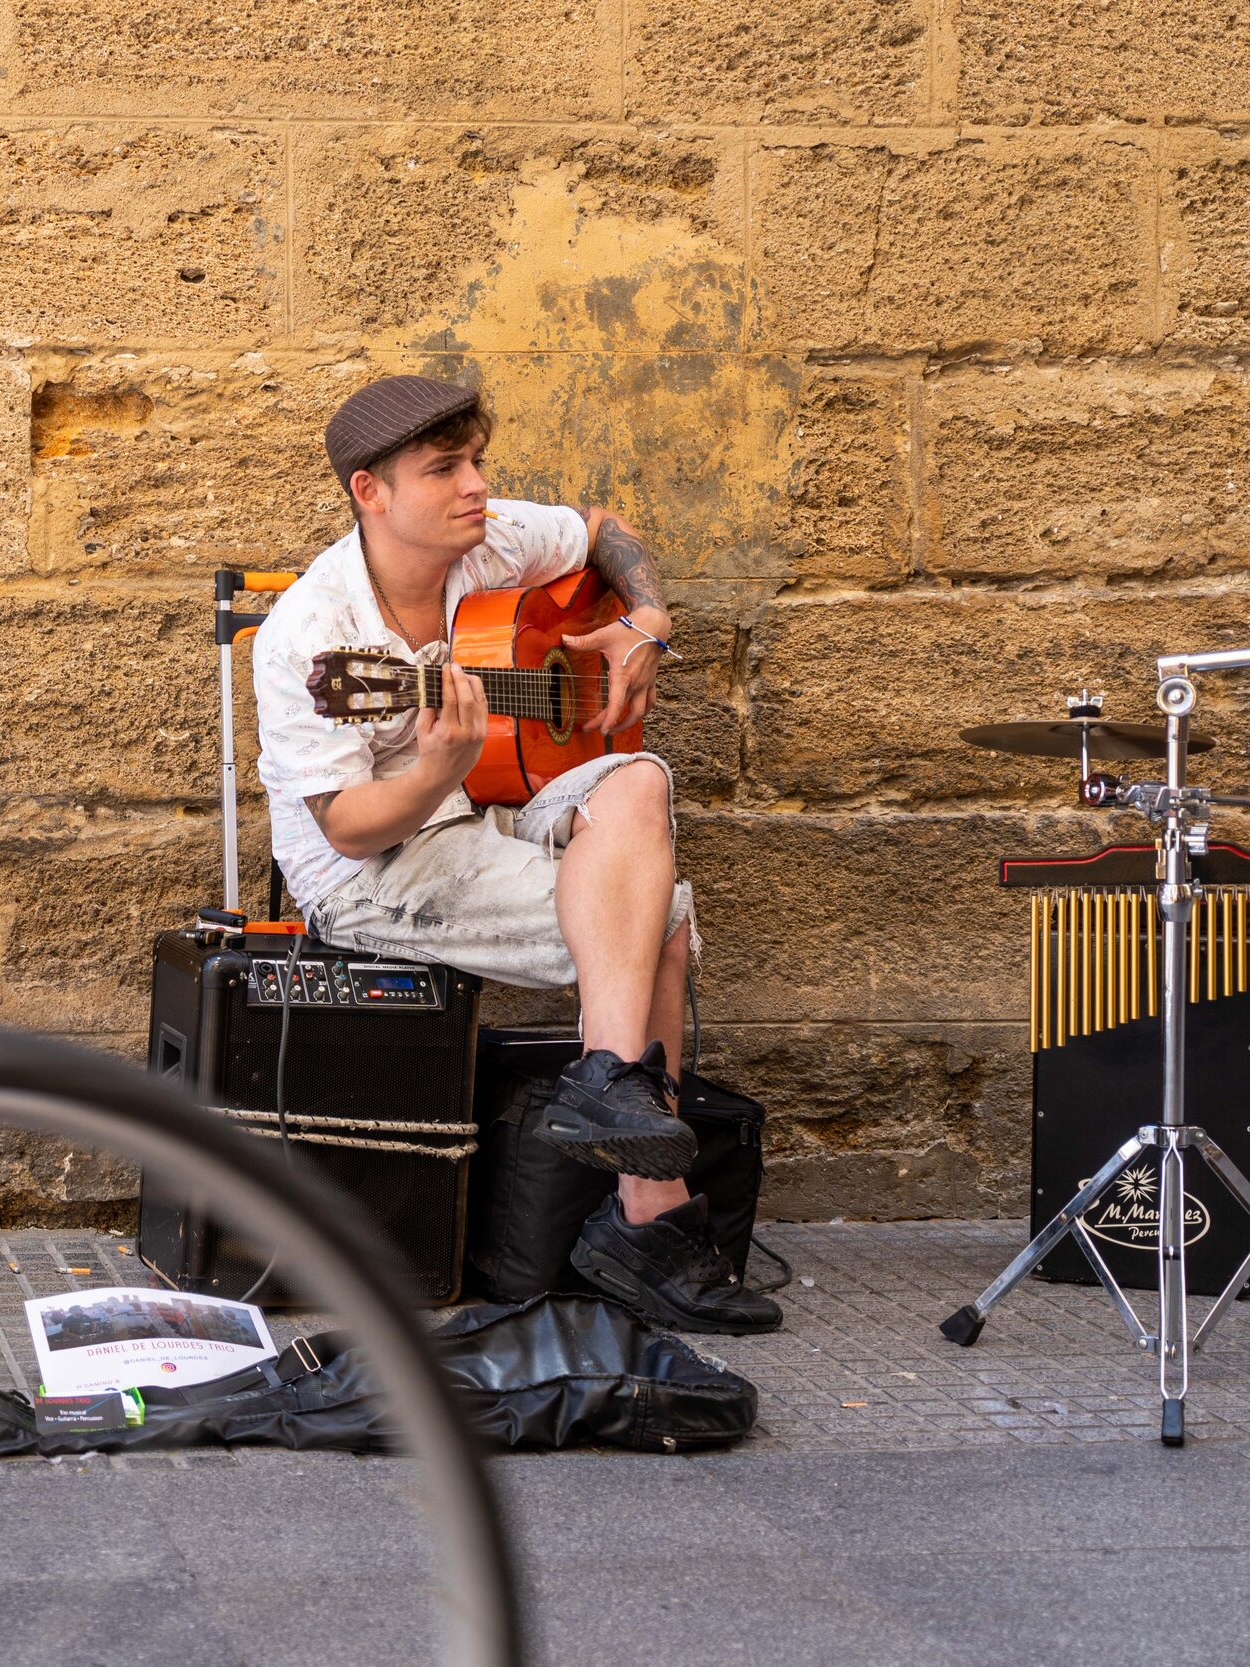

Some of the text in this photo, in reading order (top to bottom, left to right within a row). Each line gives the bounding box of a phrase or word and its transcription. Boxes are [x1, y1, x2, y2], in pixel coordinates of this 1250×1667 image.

[87, 1341, 235, 1357] DANIEL DE LOURDES TRIO
